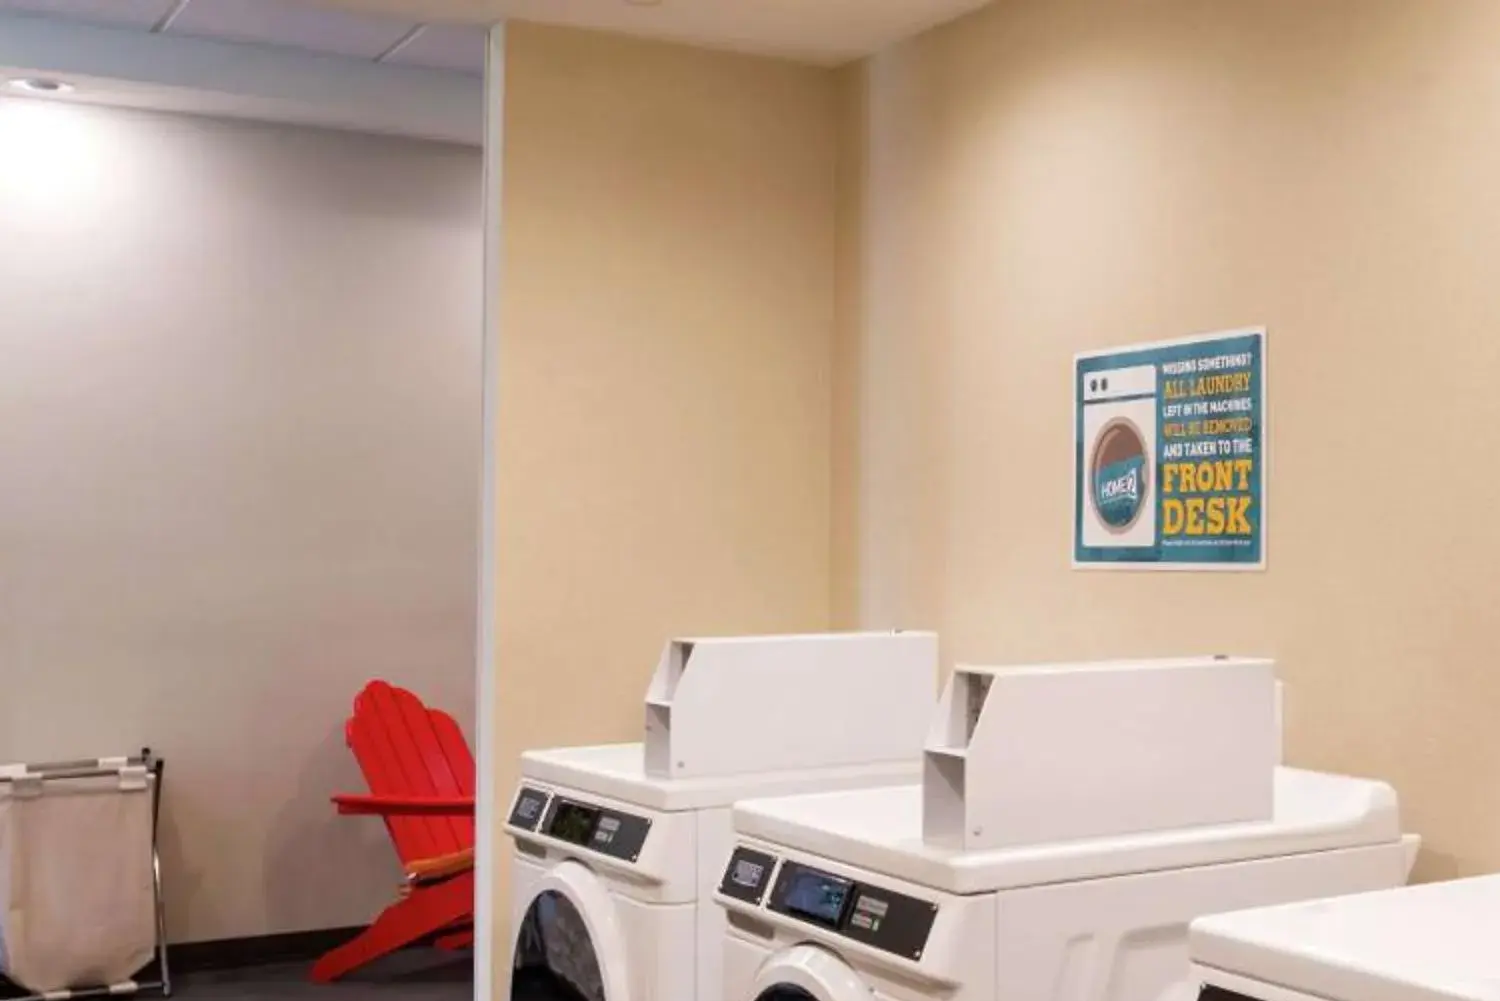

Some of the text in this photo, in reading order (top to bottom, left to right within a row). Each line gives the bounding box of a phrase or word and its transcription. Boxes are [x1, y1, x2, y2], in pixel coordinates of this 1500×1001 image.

[1163, 371, 1252, 399] ALL LAUNDRY
[1162, 403, 1183, 419] LEFT
[1162, 437, 1253, 458] AND TAKEN TO THE
[1162, 458, 1253, 494] FRONT
[1162, 495, 1252, 536] DESK
